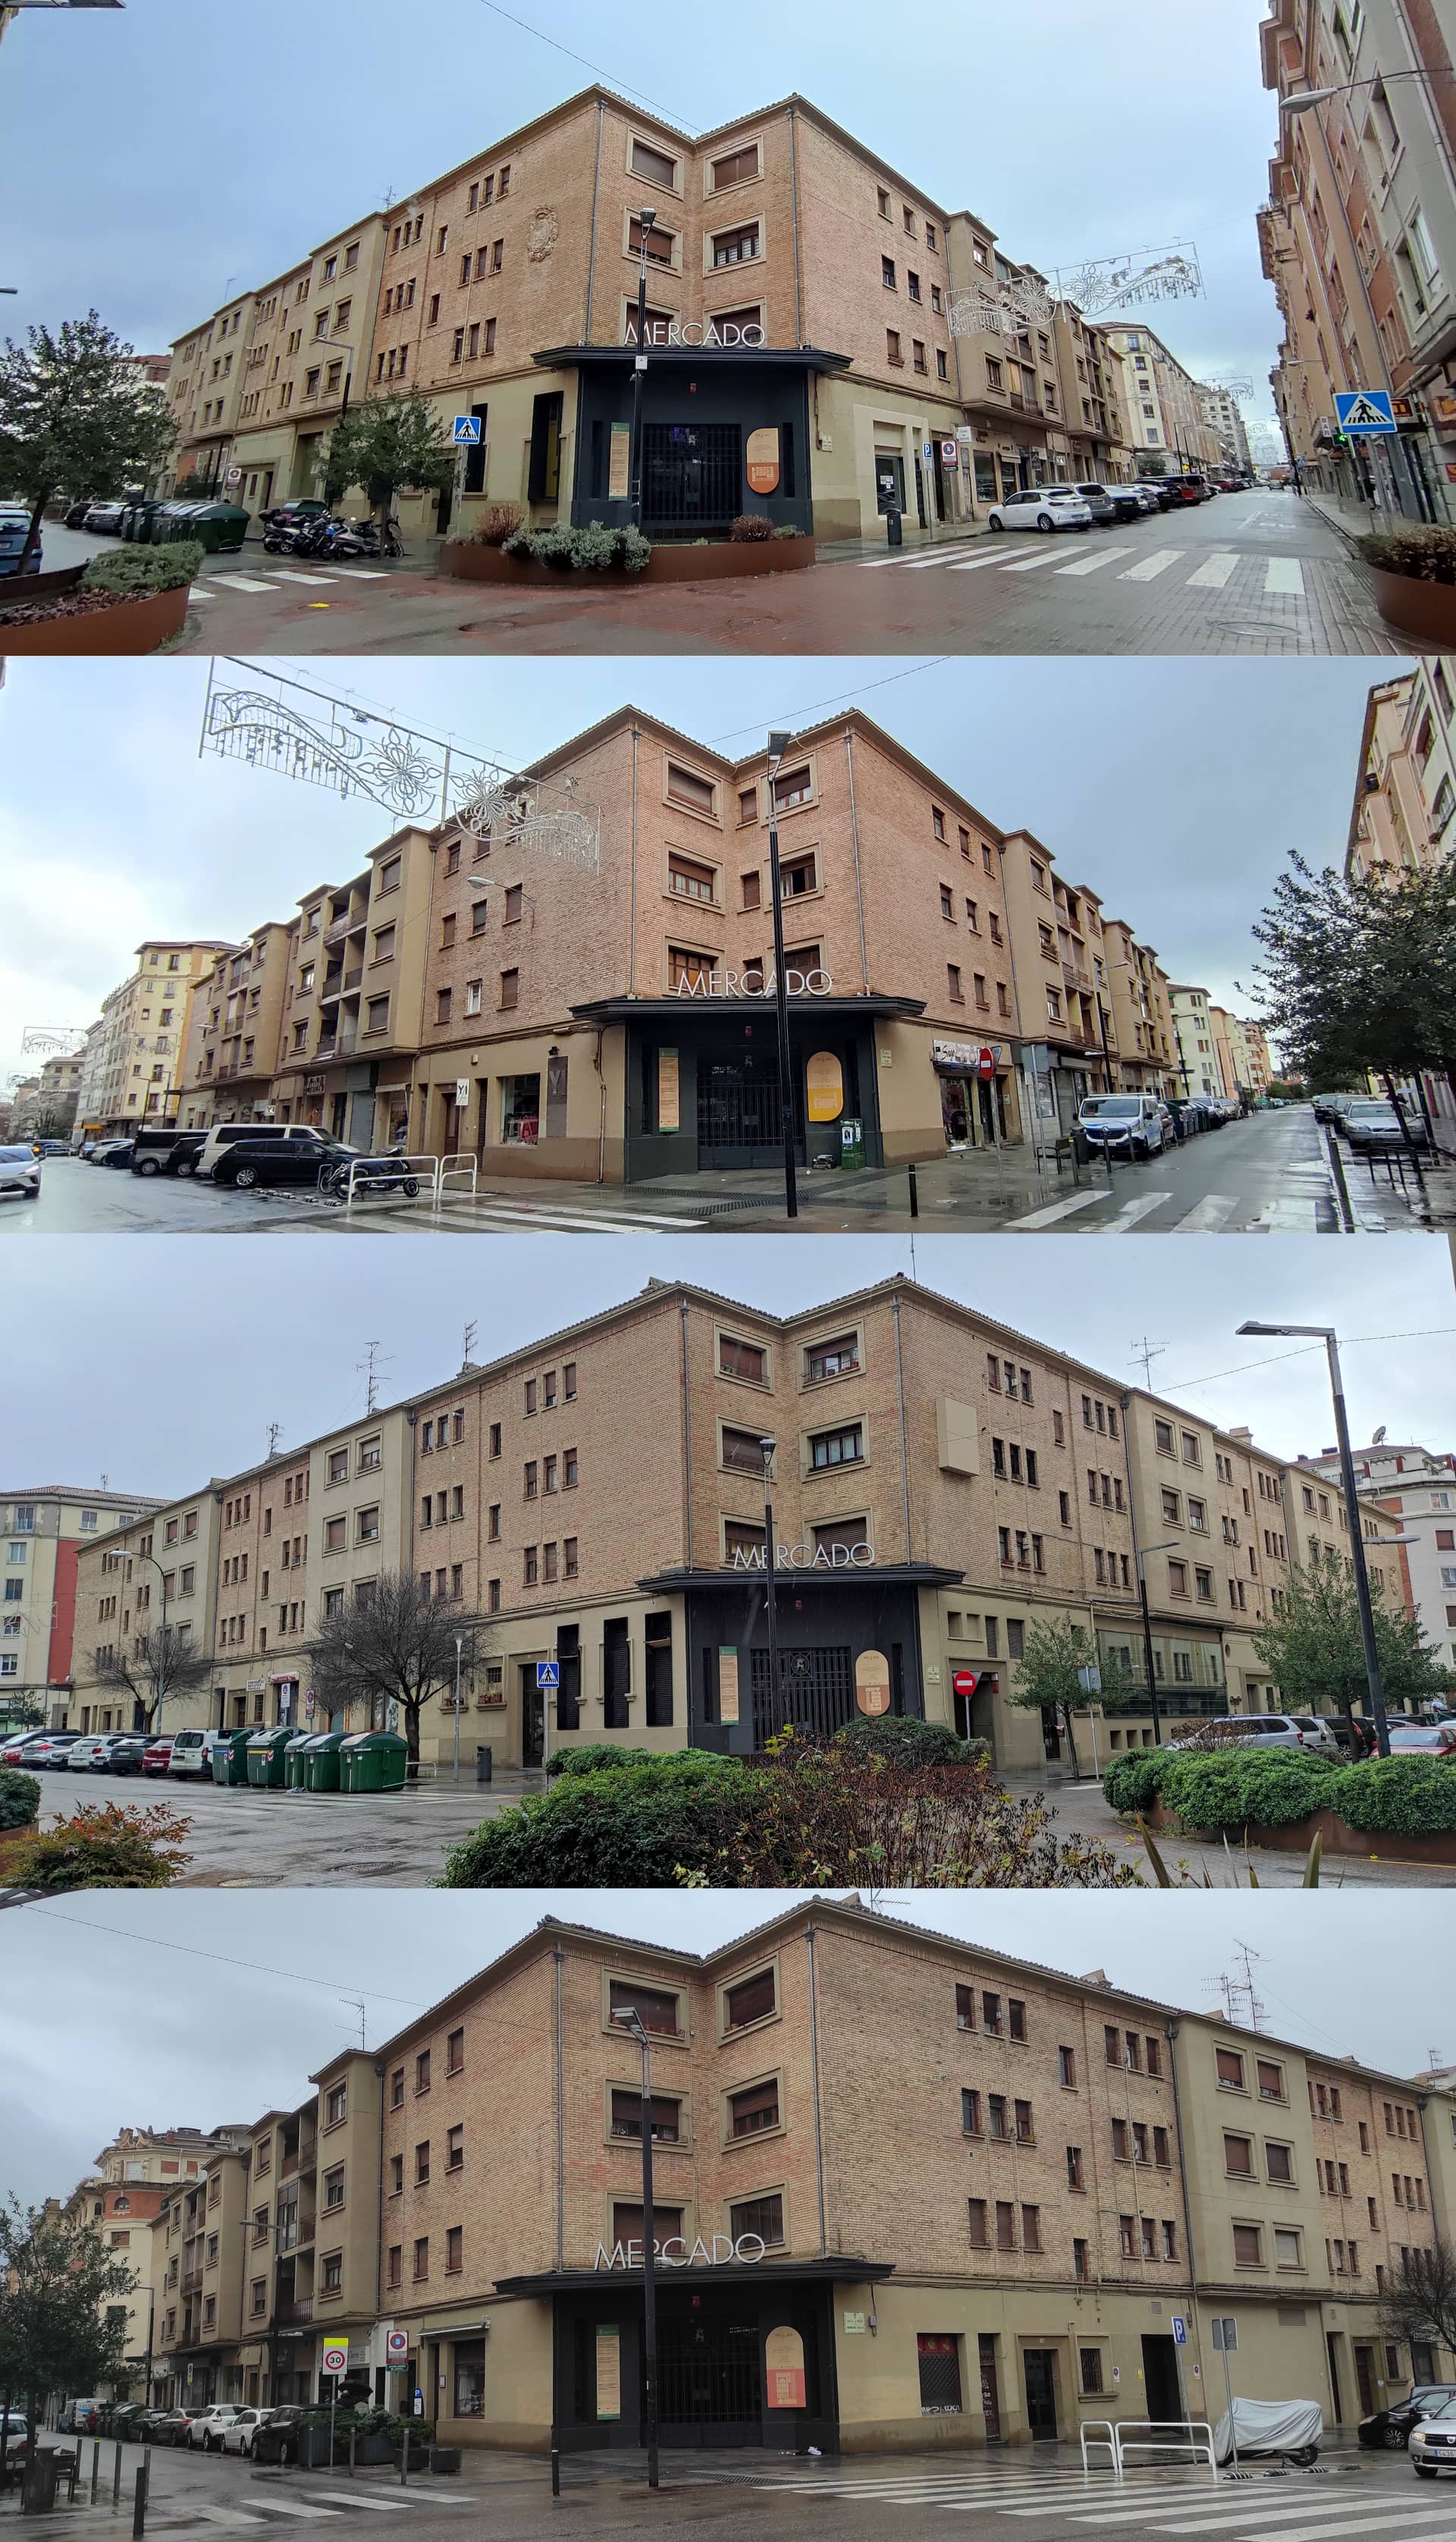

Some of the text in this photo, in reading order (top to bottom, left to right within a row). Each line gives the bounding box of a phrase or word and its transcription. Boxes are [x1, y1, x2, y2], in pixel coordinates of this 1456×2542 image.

[624, 321, 765, 347] MERCADO
[1322, 418, 1330, 435] BAR
[677, 969, 833, 998] MERCADO
[733, 1543, 875, 1570] MERCADO
